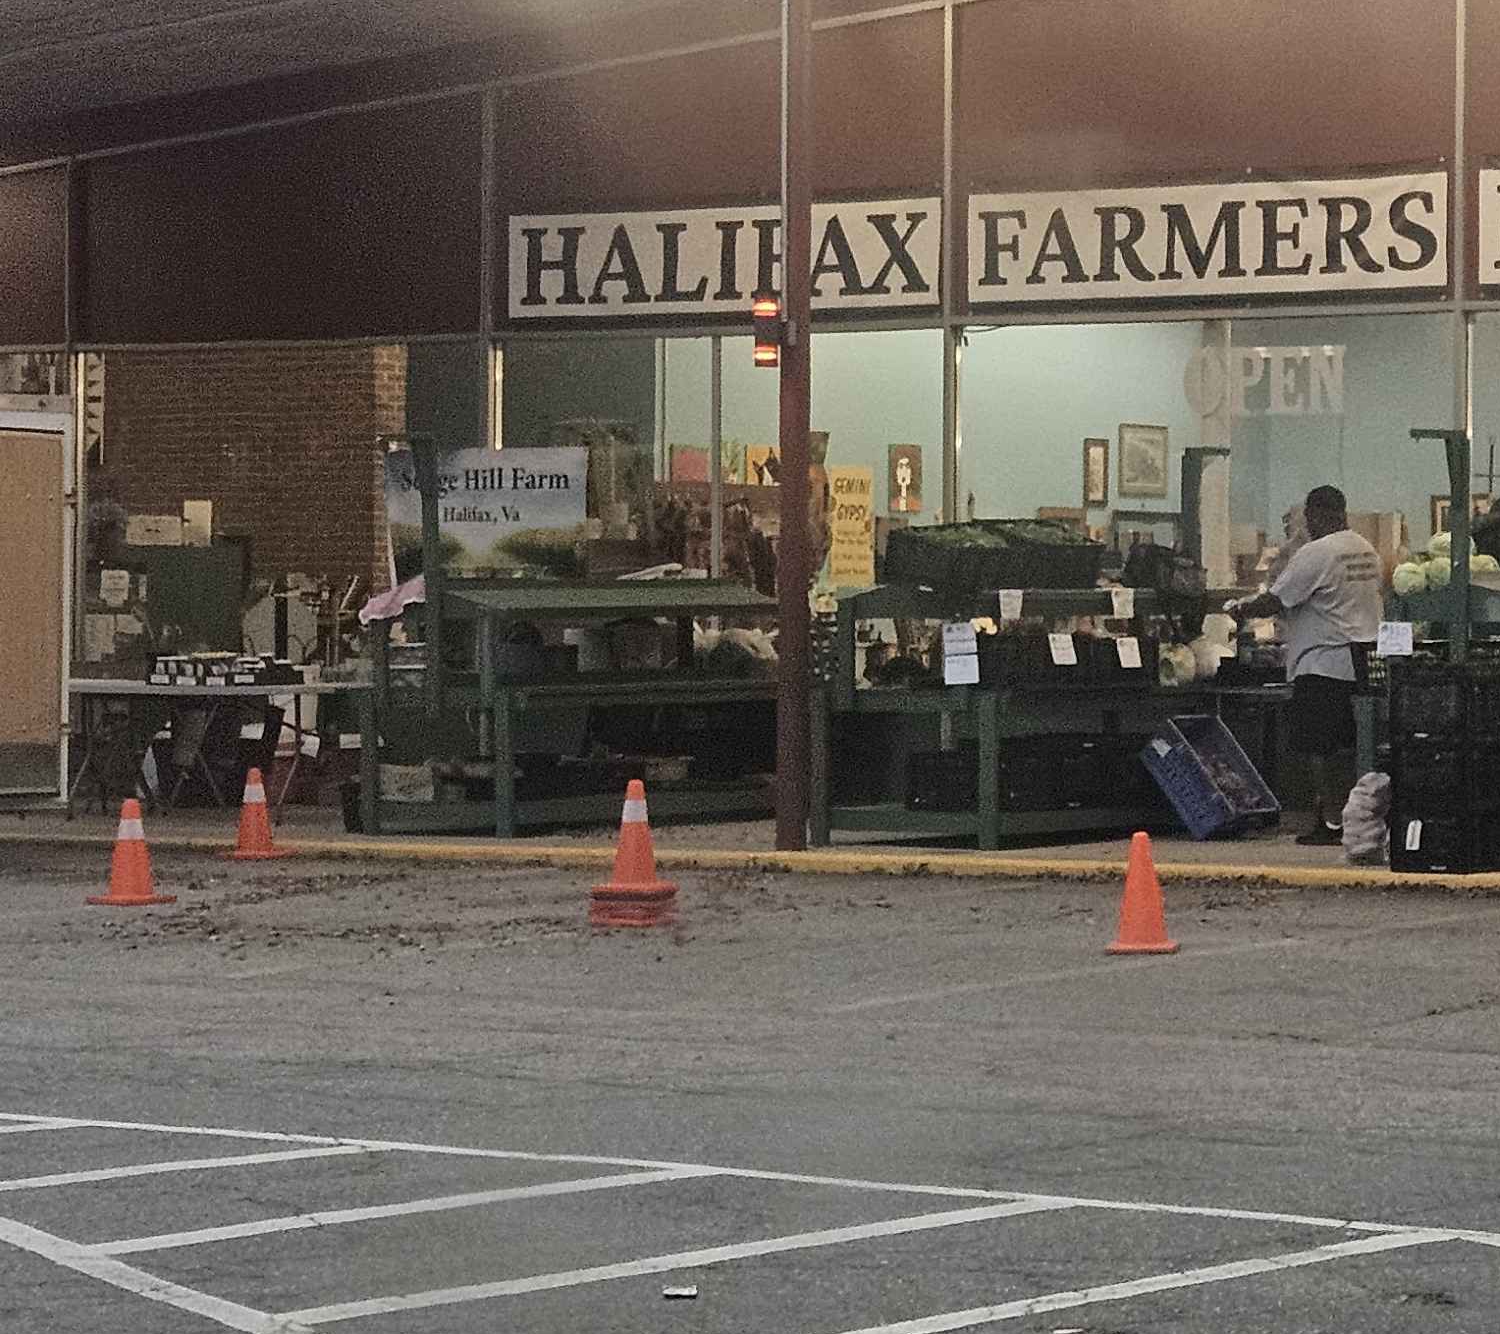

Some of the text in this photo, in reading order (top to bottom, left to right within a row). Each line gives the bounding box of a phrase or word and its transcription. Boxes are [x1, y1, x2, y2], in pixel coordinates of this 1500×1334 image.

[520, 211, 931, 306] HALIFAX
[977, 190, 1439, 286] FARMERS
[1183, 345, 1345, 418] OPEN
[464, 467, 504, 491] Hill
[512, 467, 570, 491] Farm
[833, 477, 872, 494] GEMINI
[443, 505, 521, 526] Halifax, Va
